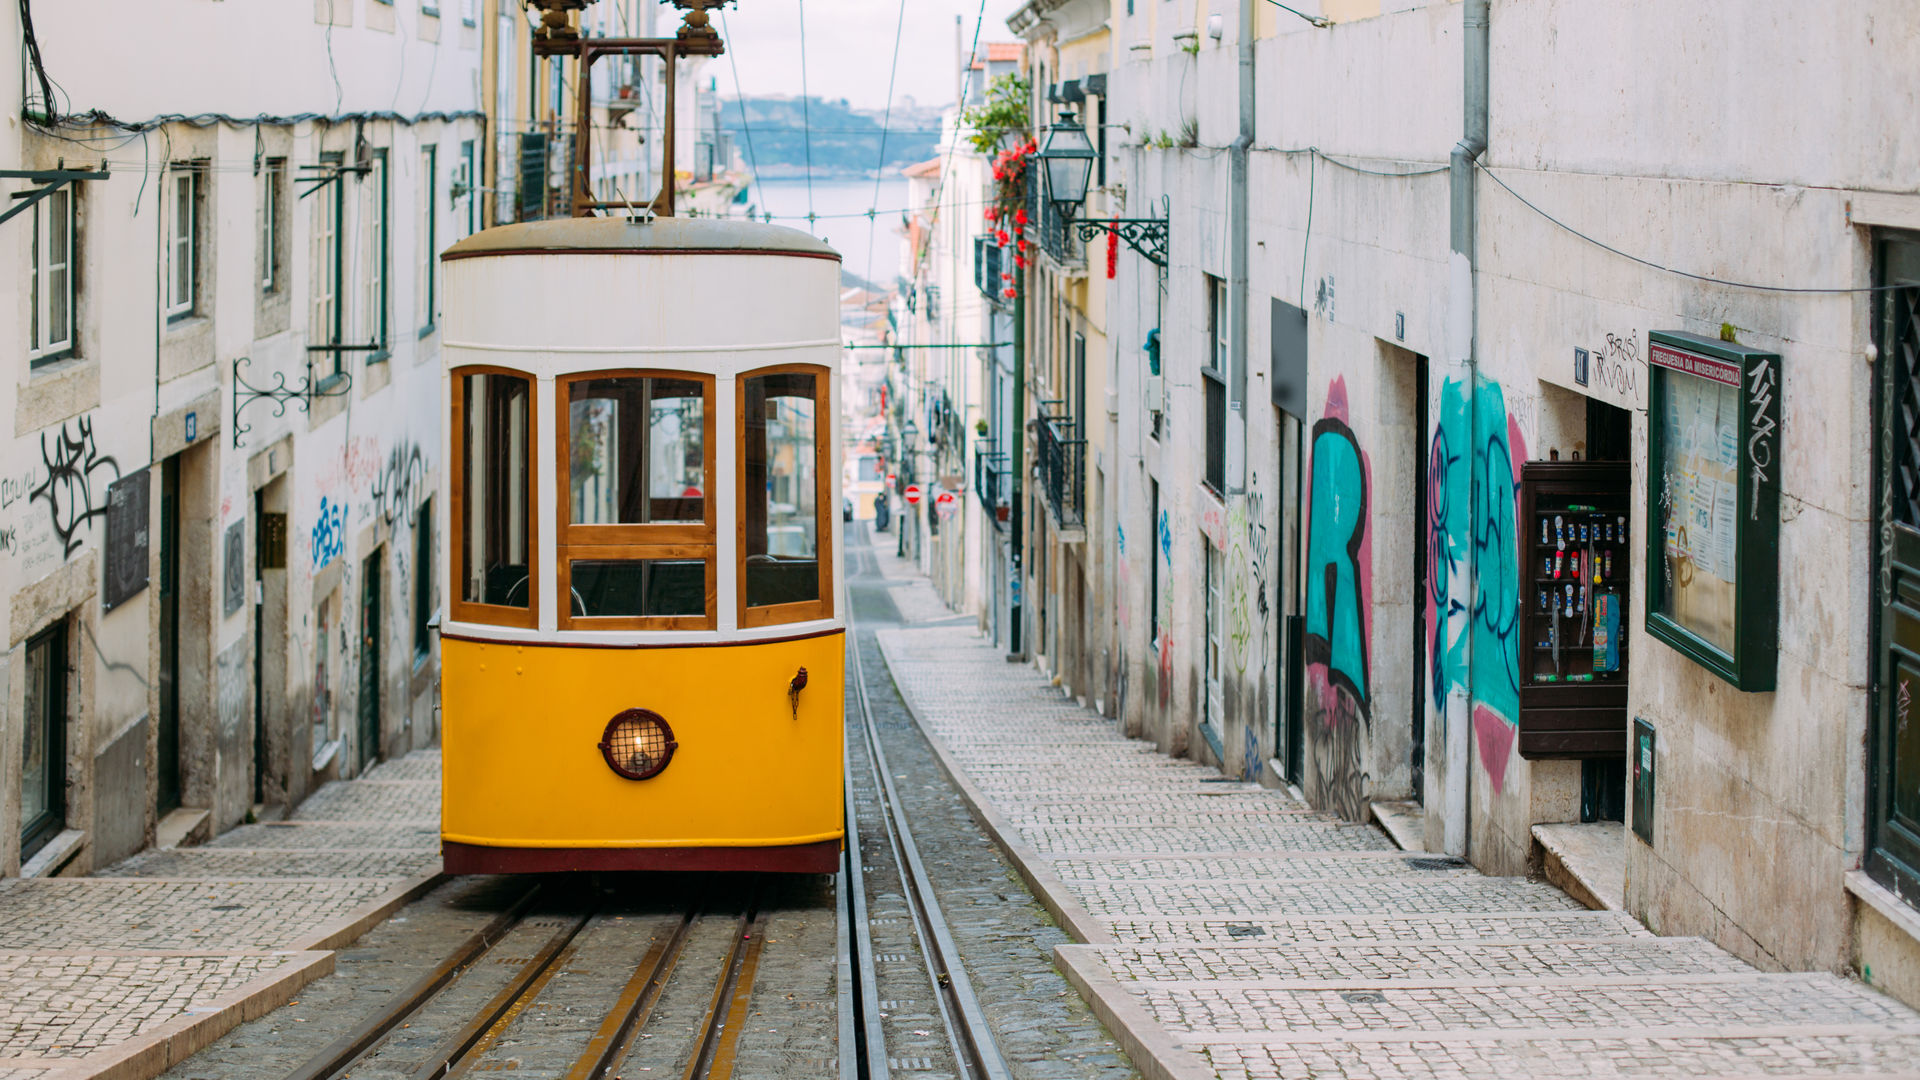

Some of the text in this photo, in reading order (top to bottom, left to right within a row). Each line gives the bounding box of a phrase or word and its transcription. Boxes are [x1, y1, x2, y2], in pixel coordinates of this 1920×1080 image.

[1651, 349, 1739, 384] FREGUESIA DA MISERICÓRDIA
